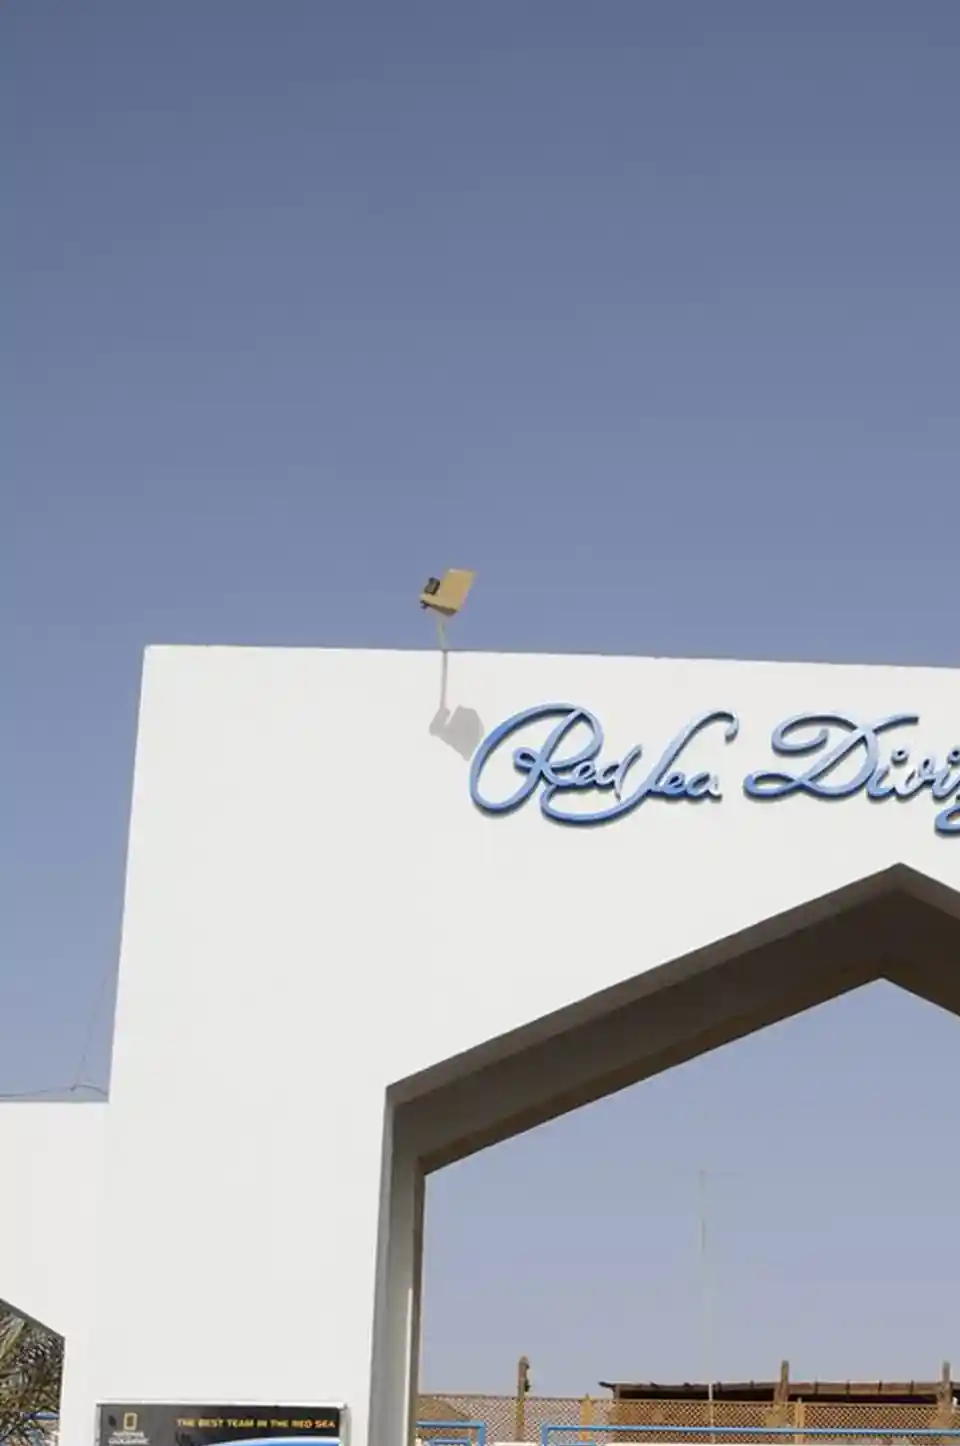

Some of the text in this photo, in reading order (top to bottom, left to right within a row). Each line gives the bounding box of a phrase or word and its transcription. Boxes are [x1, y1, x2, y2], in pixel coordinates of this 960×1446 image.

[469, 702, 642, 826] Red
[199, 1418, 223, 1428] BEST
[227, 1418, 254, 1429] TEAM
[256, 1419, 267, 1429] IN
[270, 1419, 289, 1429] THE
[291, 1419, 312, 1429] RED
[314, 1420, 336, 1429] SEA
